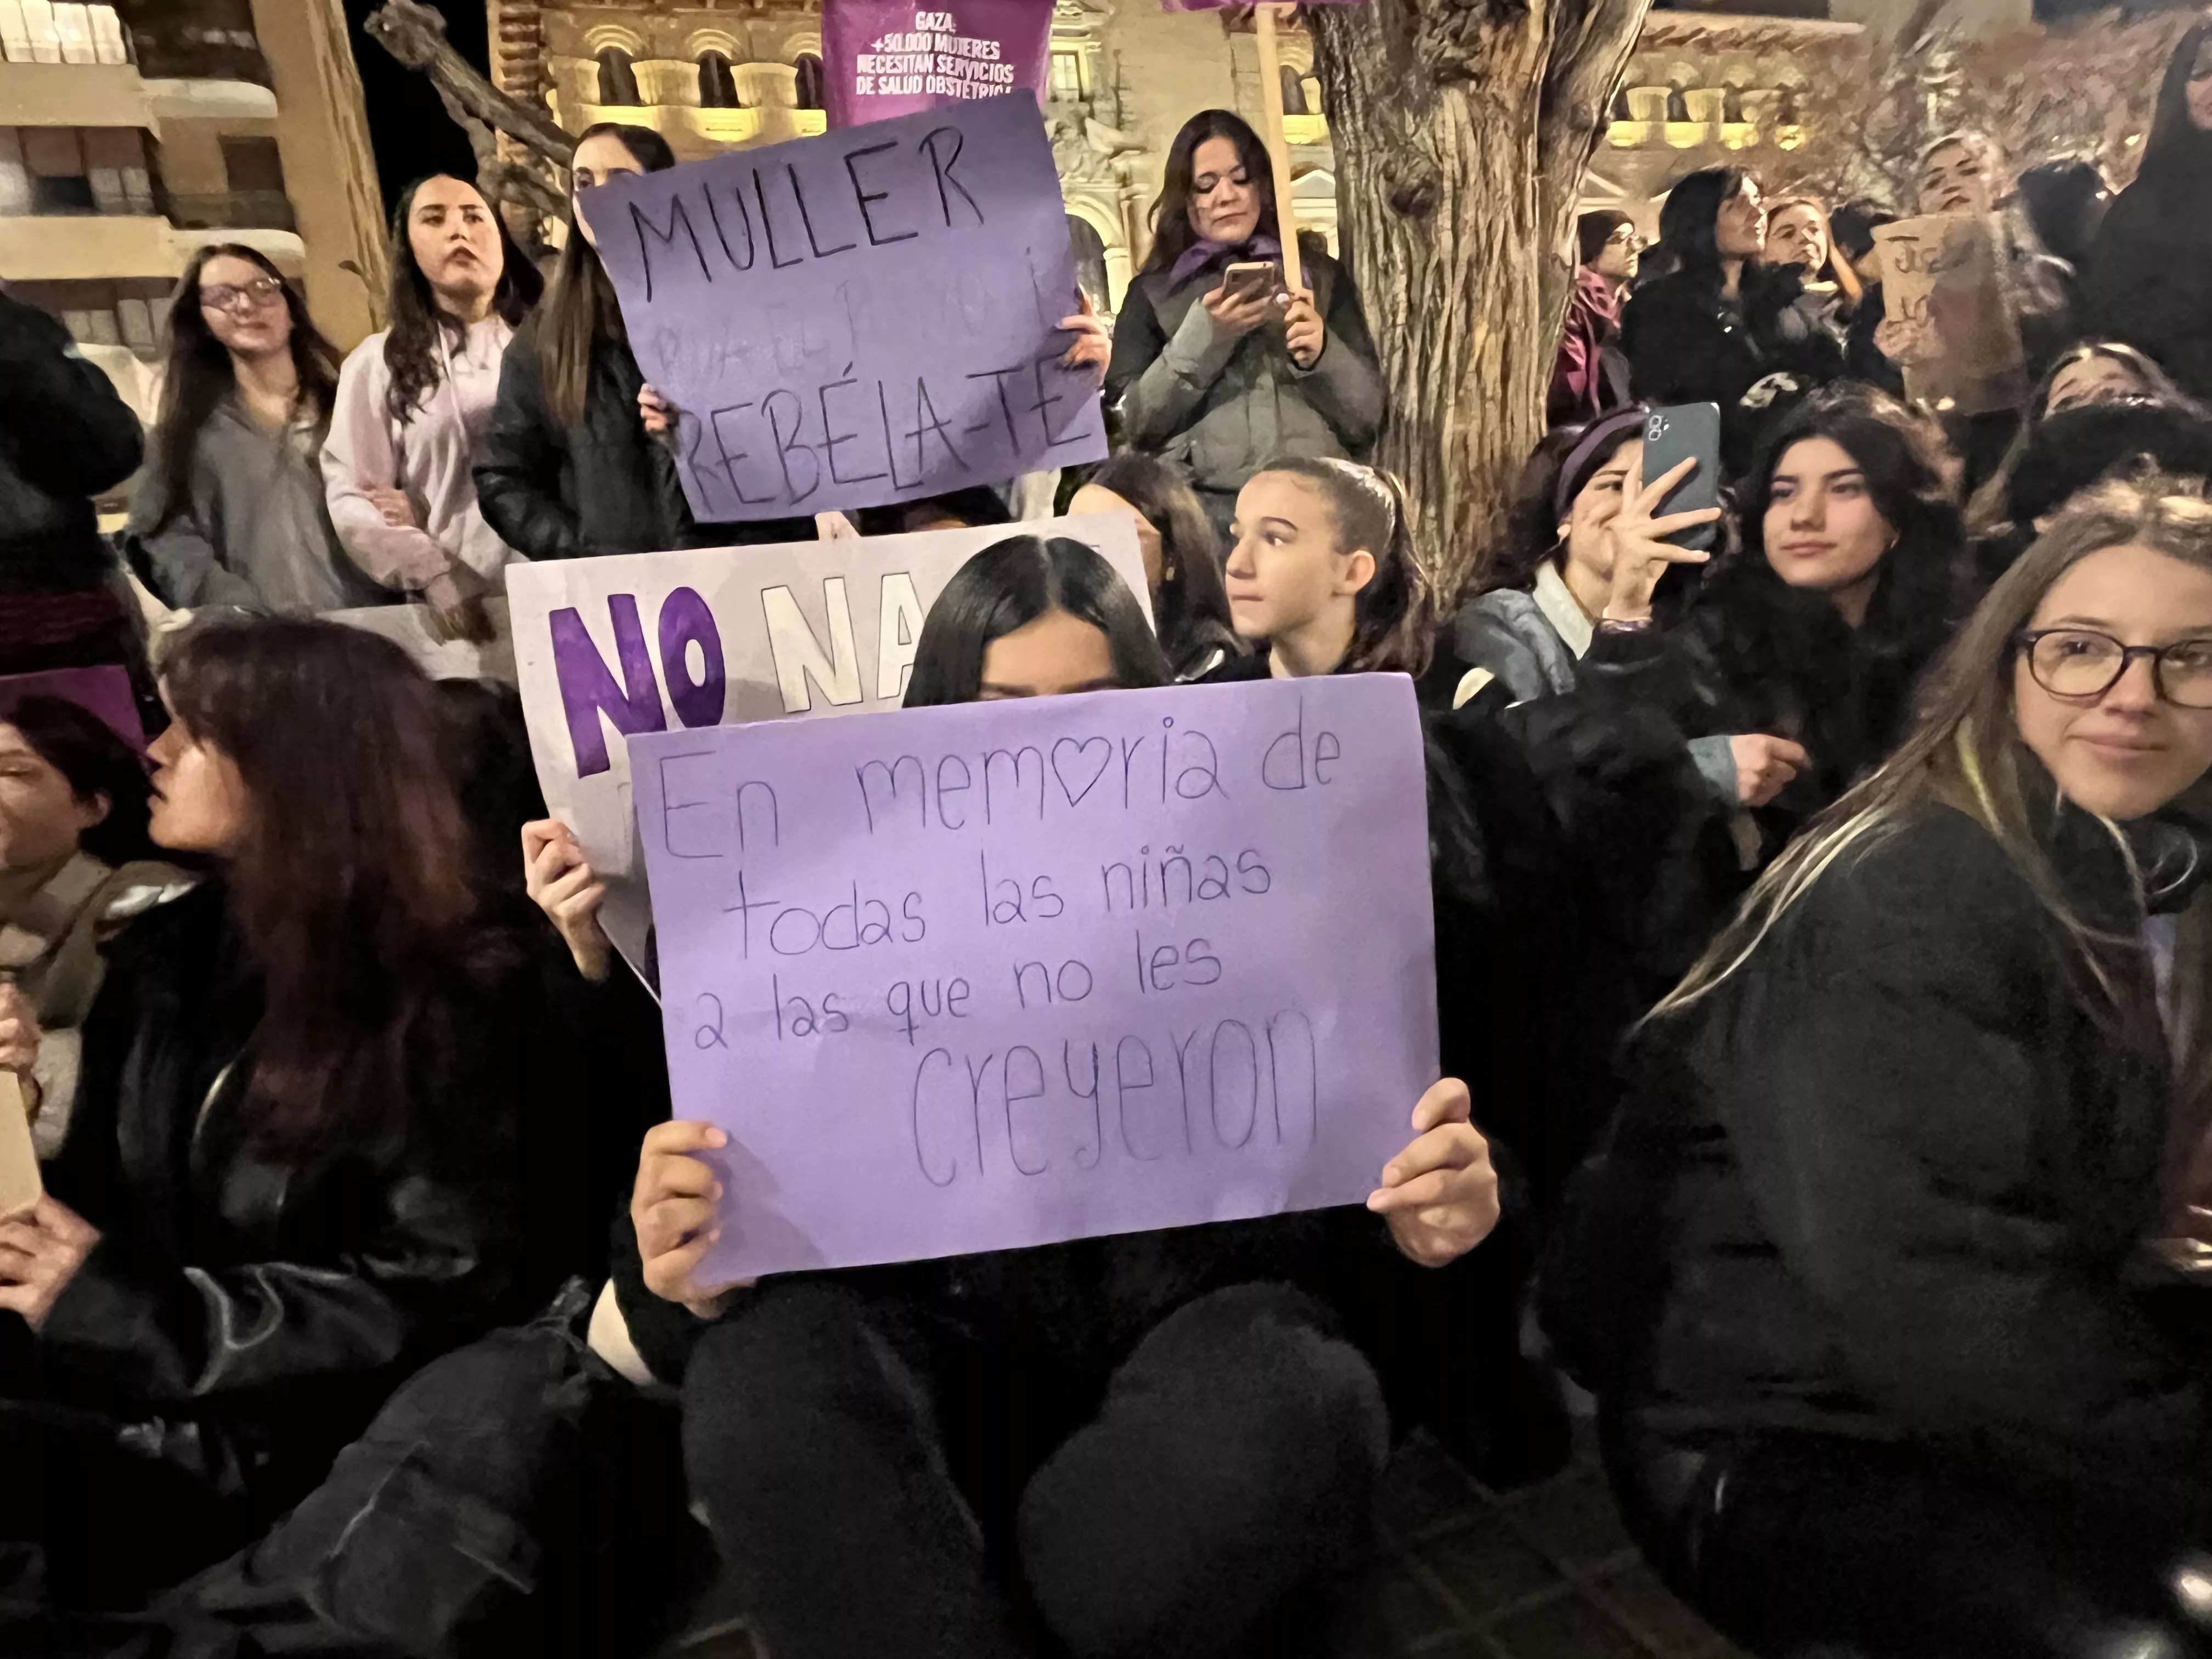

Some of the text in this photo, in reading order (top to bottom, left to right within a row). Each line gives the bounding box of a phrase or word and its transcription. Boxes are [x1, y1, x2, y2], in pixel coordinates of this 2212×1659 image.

[856, 76, 876, 95] DE
[878, 75, 922, 95] SALUD
[857, 54, 1014, 83] NECESITAN SERVICIOS
[628, 126, 984, 303] MULLER
[549, 586, 726, 779] NO
[659, 750, 779, 859] En
[1262, 693, 1341, 791] de
[723, 842, 1272, 960] todas las niñas
[693, 929, 1222, 1048] a las que no les
[912, 1008, 1317, 1187] creyeron
